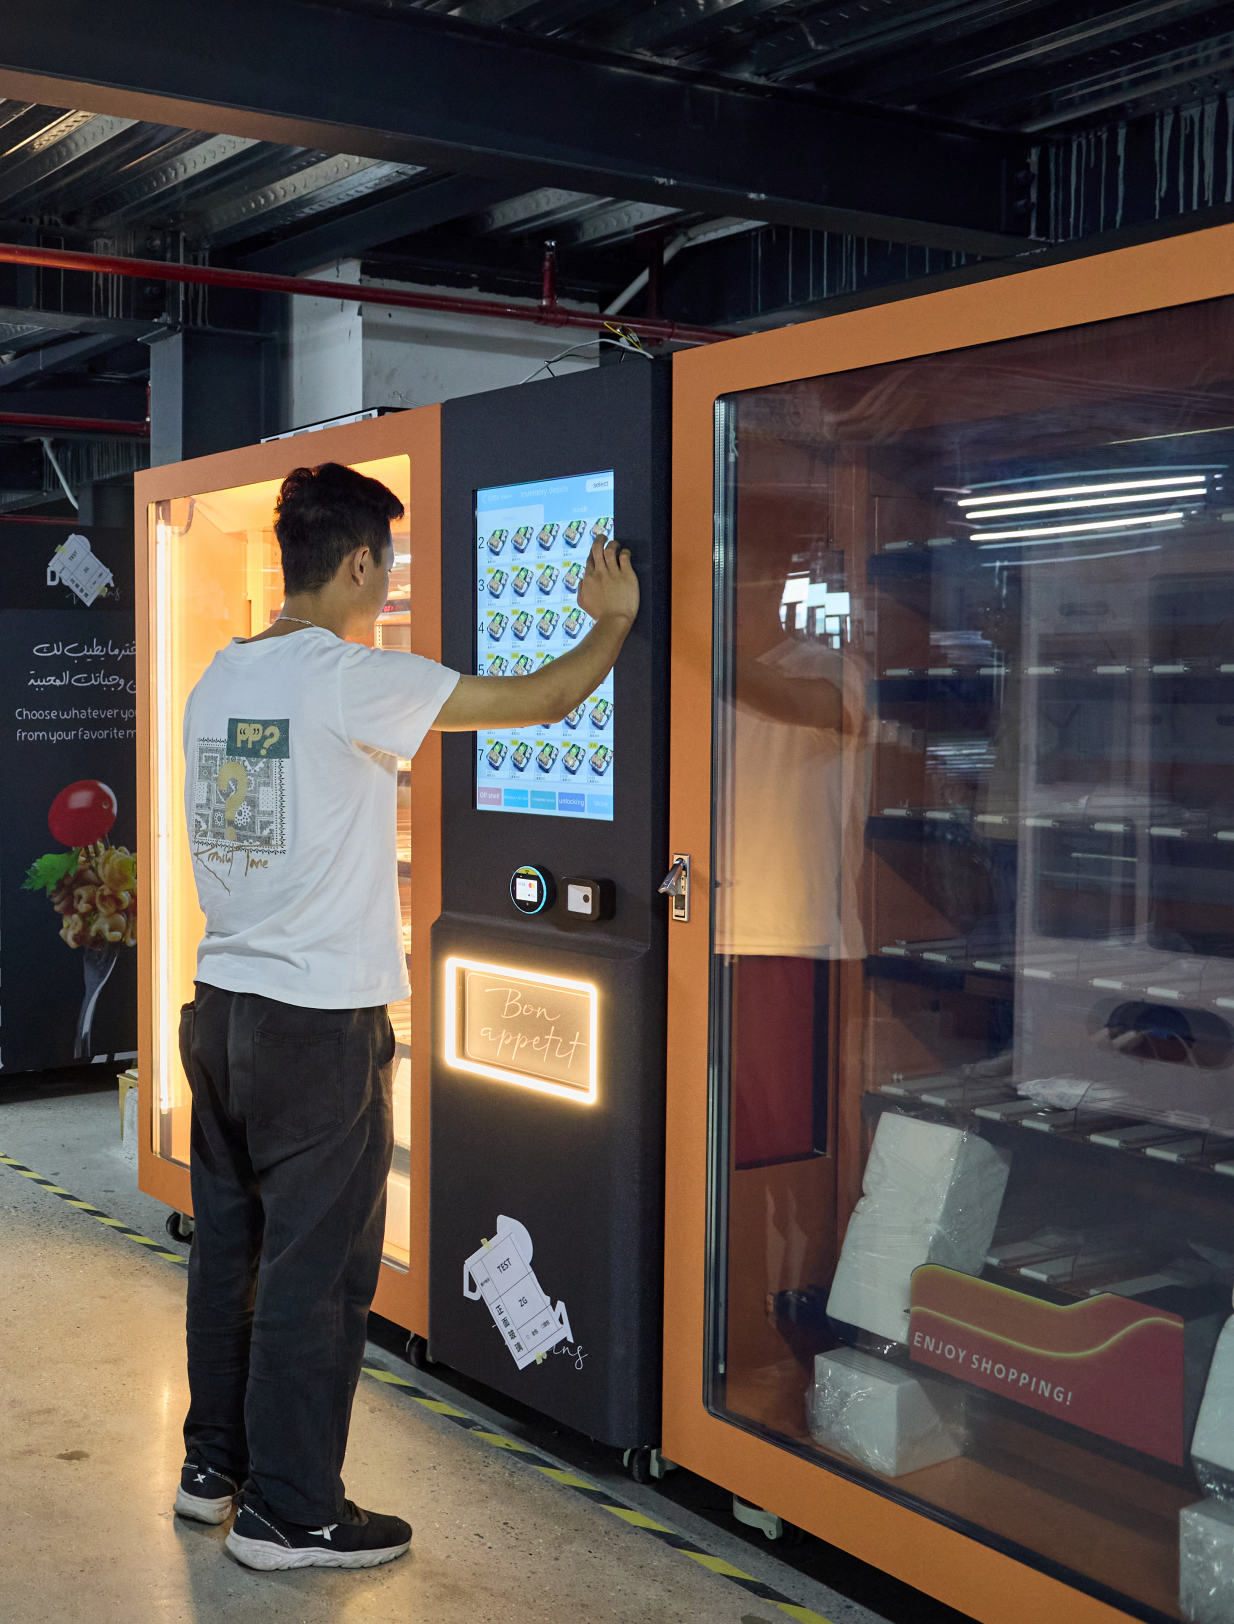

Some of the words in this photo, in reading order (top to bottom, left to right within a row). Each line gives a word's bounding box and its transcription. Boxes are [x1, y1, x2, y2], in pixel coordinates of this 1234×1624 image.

[478, 536, 484, 549] 2
[478, 579, 484, 591] 3
[478, 621, 484, 634] 4
[478, 663, 484, 676] 5
[15, 707, 57, 720] Choose
[59, 707, 119, 719] whatever
[120, 709, 136, 722] yo
[16, 729, 47, 742] from
[48, 731, 77, 744] your
[78, 727, 125, 741] favorite
[478, 748, 484, 761] 7
[485, 987, 561, 1021] Bon
[480, 1025, 588, 1069] appetit
[497, 1257, 512, 1274] TEST
[518, 1296, 528, 1308] ZG
[913, 1331, 967, 1363] ENJOY
[970, 1354, 1072, 1406] SHOPPING!
